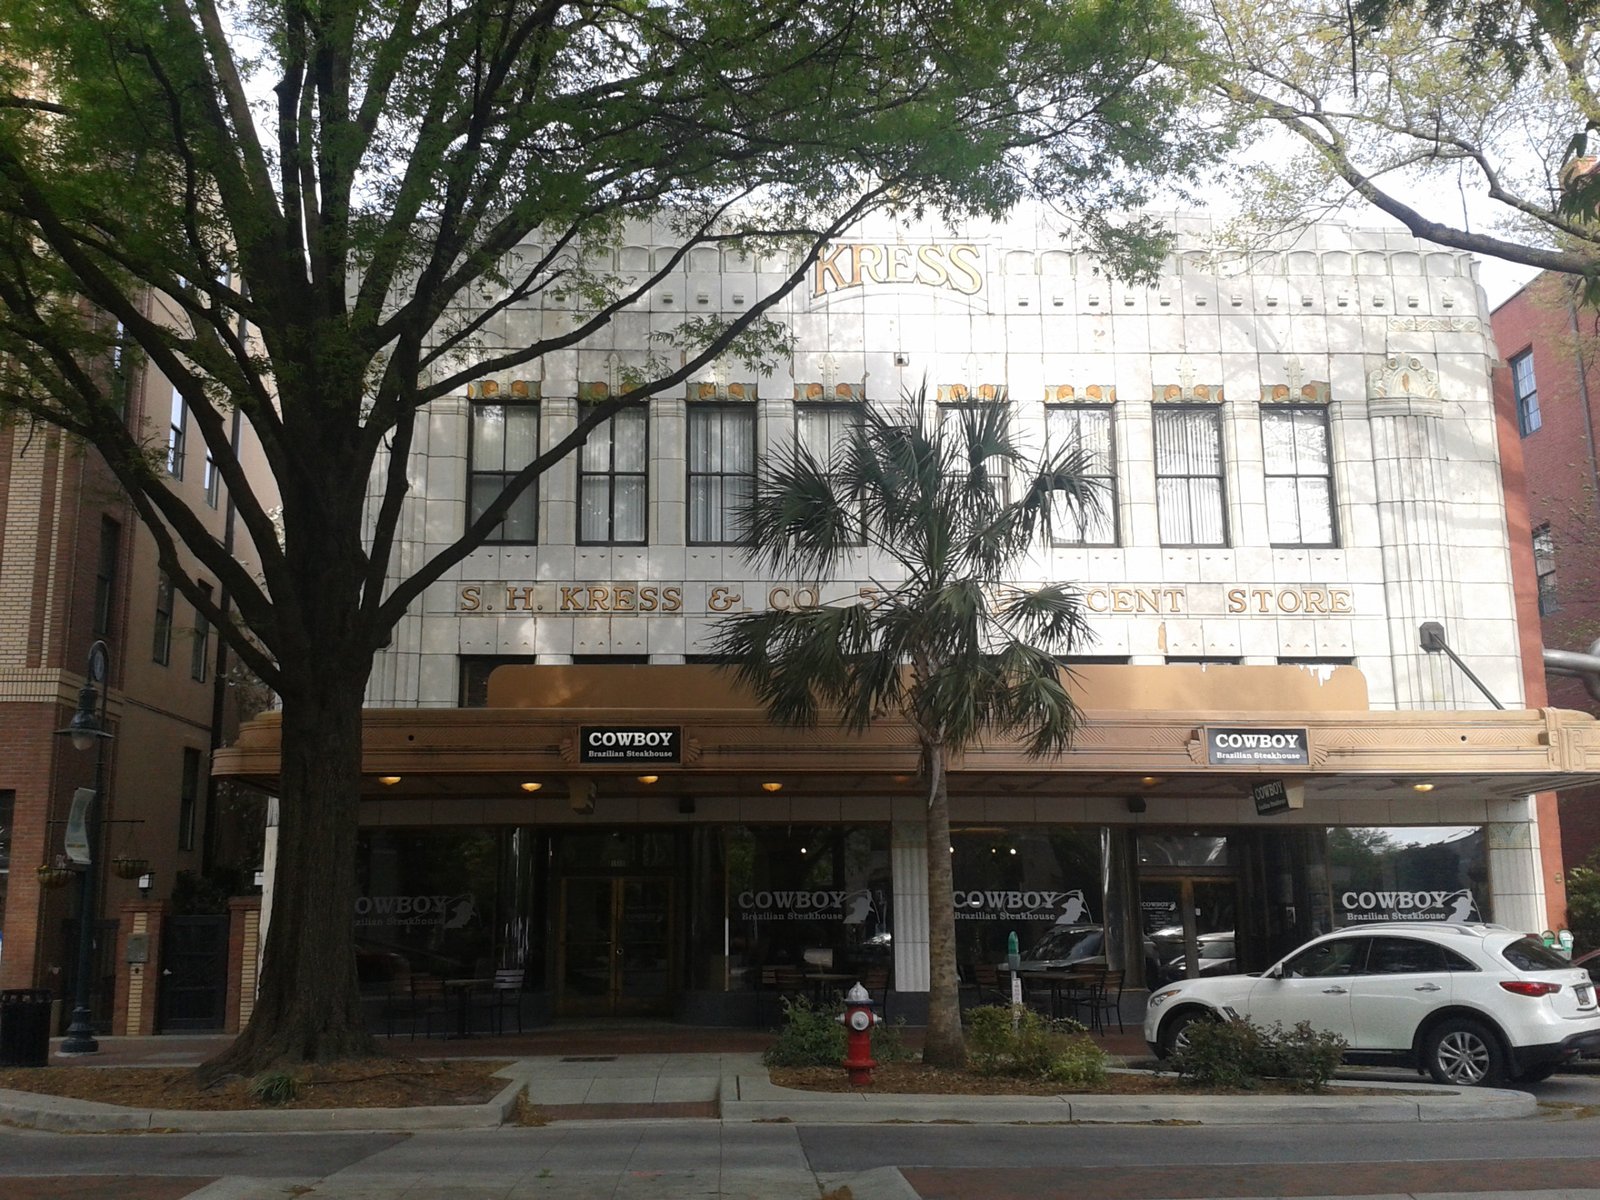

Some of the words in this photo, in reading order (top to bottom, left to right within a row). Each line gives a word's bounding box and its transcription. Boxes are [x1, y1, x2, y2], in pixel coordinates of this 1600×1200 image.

[813, 243, 983, 298] KRESS
[560, 586, 683, 612] KRESS
[707, 586, 741, 612] &
[1086, 588, 1186, 613] CENT
[1227, 588, 1353, 613] STORE
[588, 732, 673, 747] COWBOY
[1215, 733, 1299, 749] COWBOY
[588, 750, 625, 758] Brazilian
[626, 750, 673, 758] Steakhouse
[1216, 751, 1252, 759] Brazilian
[1253, 751, 1301, 760] Steakhouse
[1255, 781, 1284, 801] COWBOY
[354, 895, 449, 915] OWBOY
[738, 890, 846, 909] COWBOY
[953, 890, 1058, 909] COWBOY
[1342, 891, 1448, 910] COWBOY
[742, 912, 785, 921] Brazilian
[787, 911, 843, 921] Steakhouse
[954, 911, 997, 921] Brazilian
[999, 911, 1056, 921] Steakhouse
[1346, 912, 1390, 921] Brazilian
[1391, 912, 1446, 921] Steakhouse
